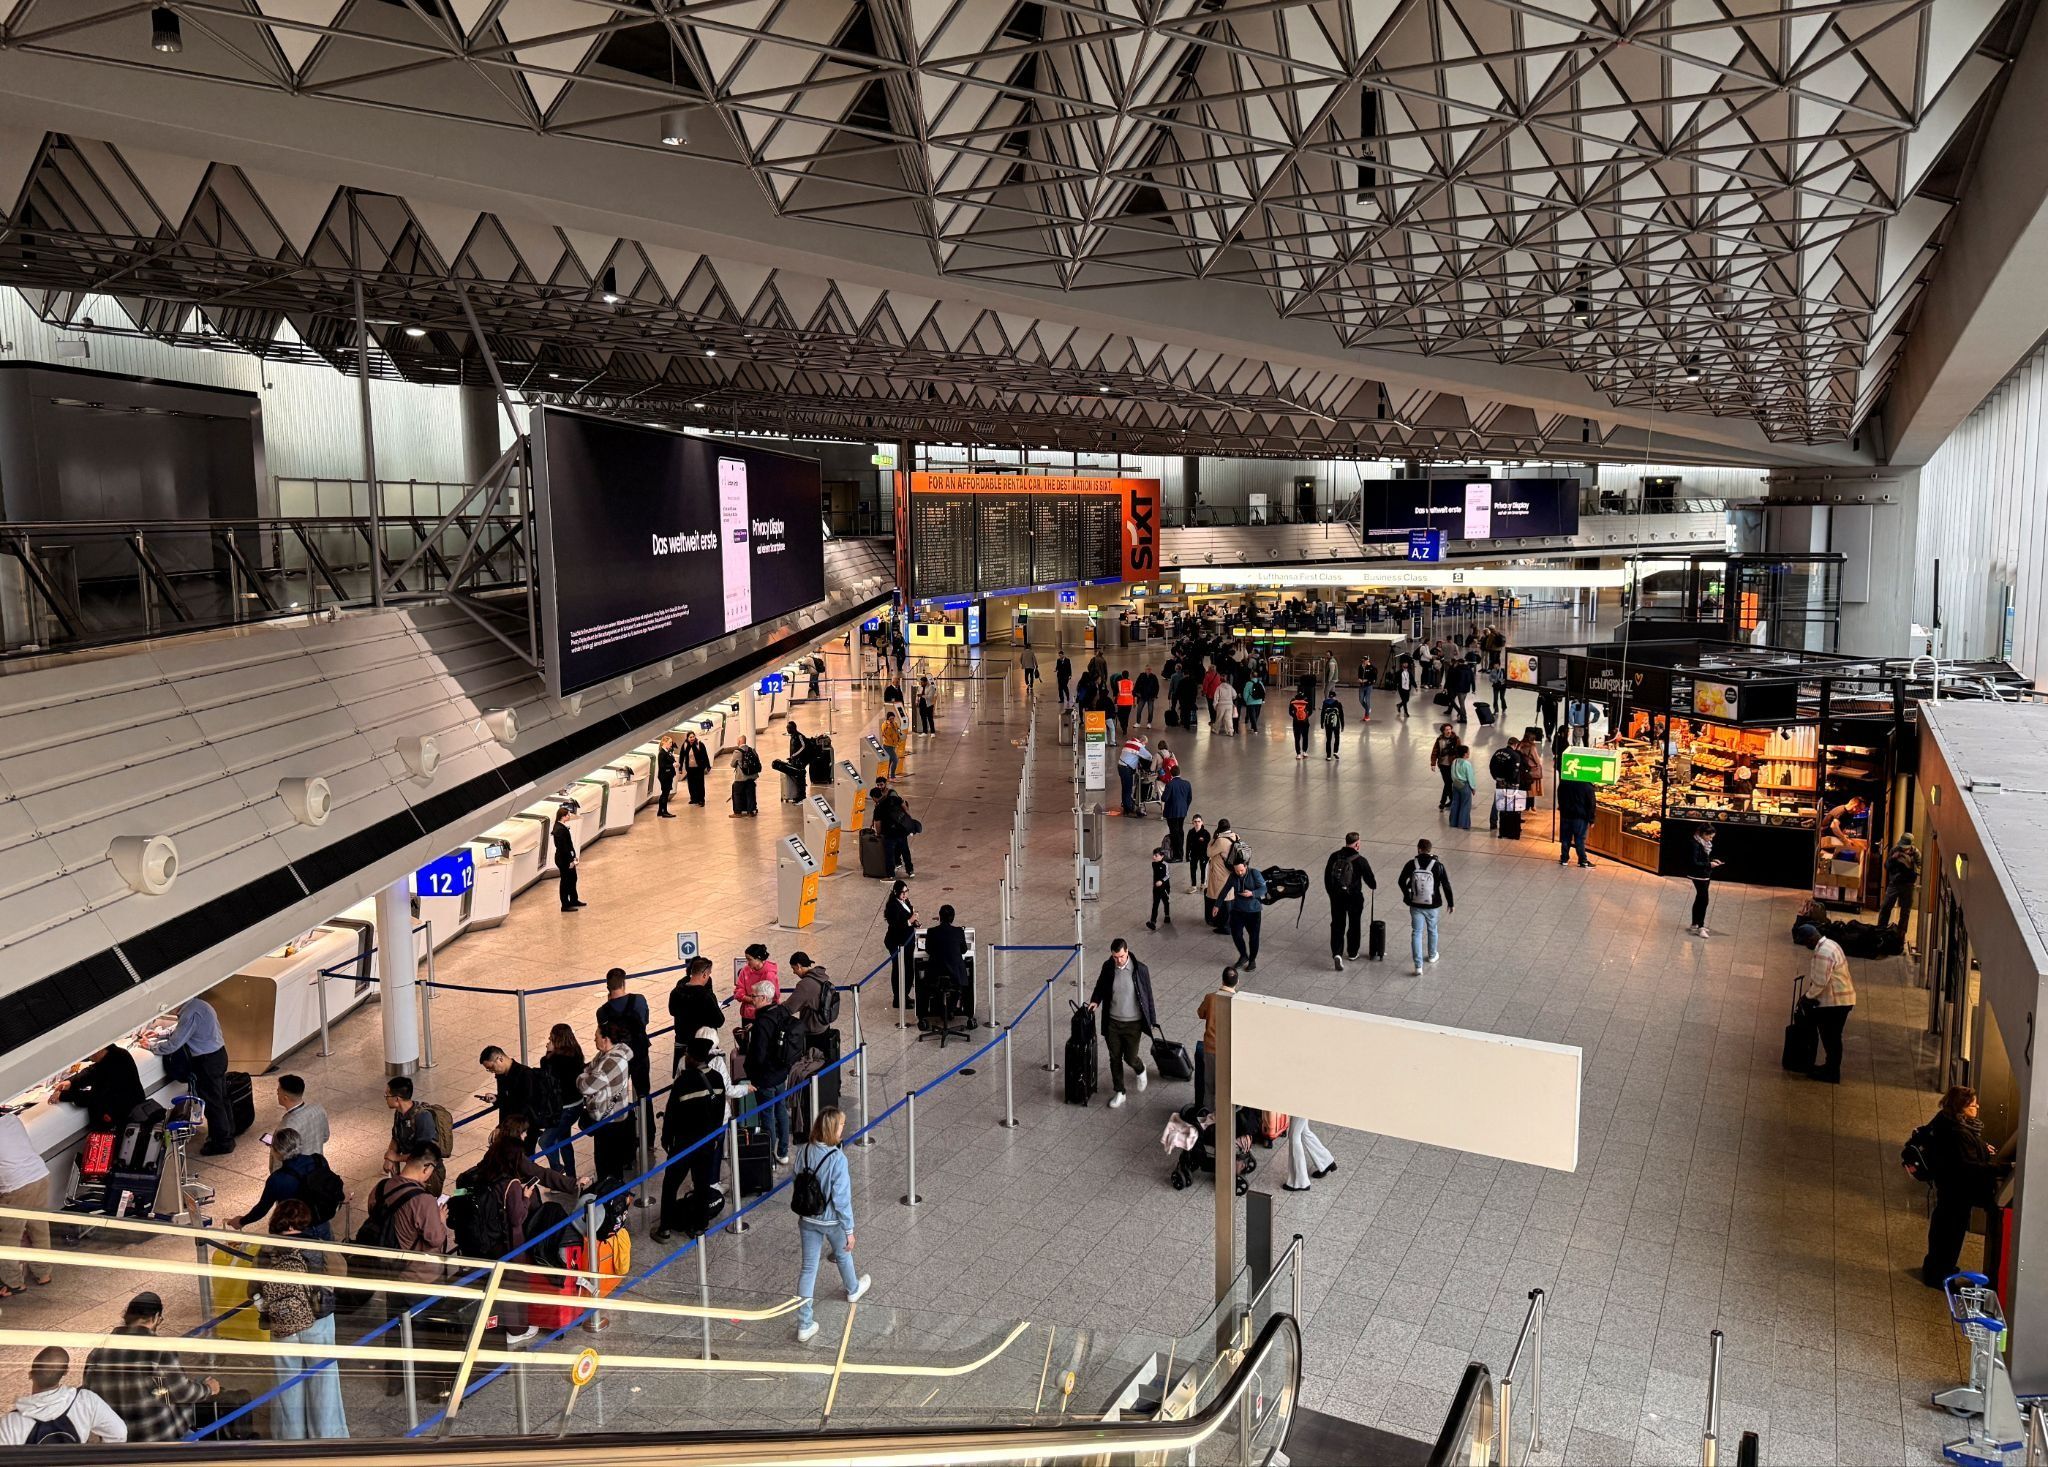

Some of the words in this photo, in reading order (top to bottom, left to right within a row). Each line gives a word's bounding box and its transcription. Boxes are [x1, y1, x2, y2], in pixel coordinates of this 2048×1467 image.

[928, 476, 944, 489] FOR
[945, 476, 956, 490] AN
[957, 477, 1002, 490] AFFORDABLE
[1003, 478, 1028, 490] RENTAL
[1044, 479, 1056, 491] THE
[1056, 479, 1093, 491] DESTINATION
[1093, 480, 1099, 491] IS
[752, 517, 769, 541] Privacy
[769, 517, 785, 540] Display
[1126, 489, 1153, 570] SIXT
[652, 533, 668, 555] Das
[668, 529, 700, 554] weltweit
[700, 529, 718, 550] erste
[1411, 547, 1430, 560] A,Z
[1258, 572, 1298, 580] Lufthansa
[1299, 572, 1317, 581] First
[1319, 573, 1342, 581] Class
[1363, 573, 1402, 581] Business
[1403, 573, 1428, 582] Class
[867, 622, 876, 630] 12
[767, 681, 779, 692] 12
[429, 873, 453, 893] 12
[462, 865, 473, 889] 12
